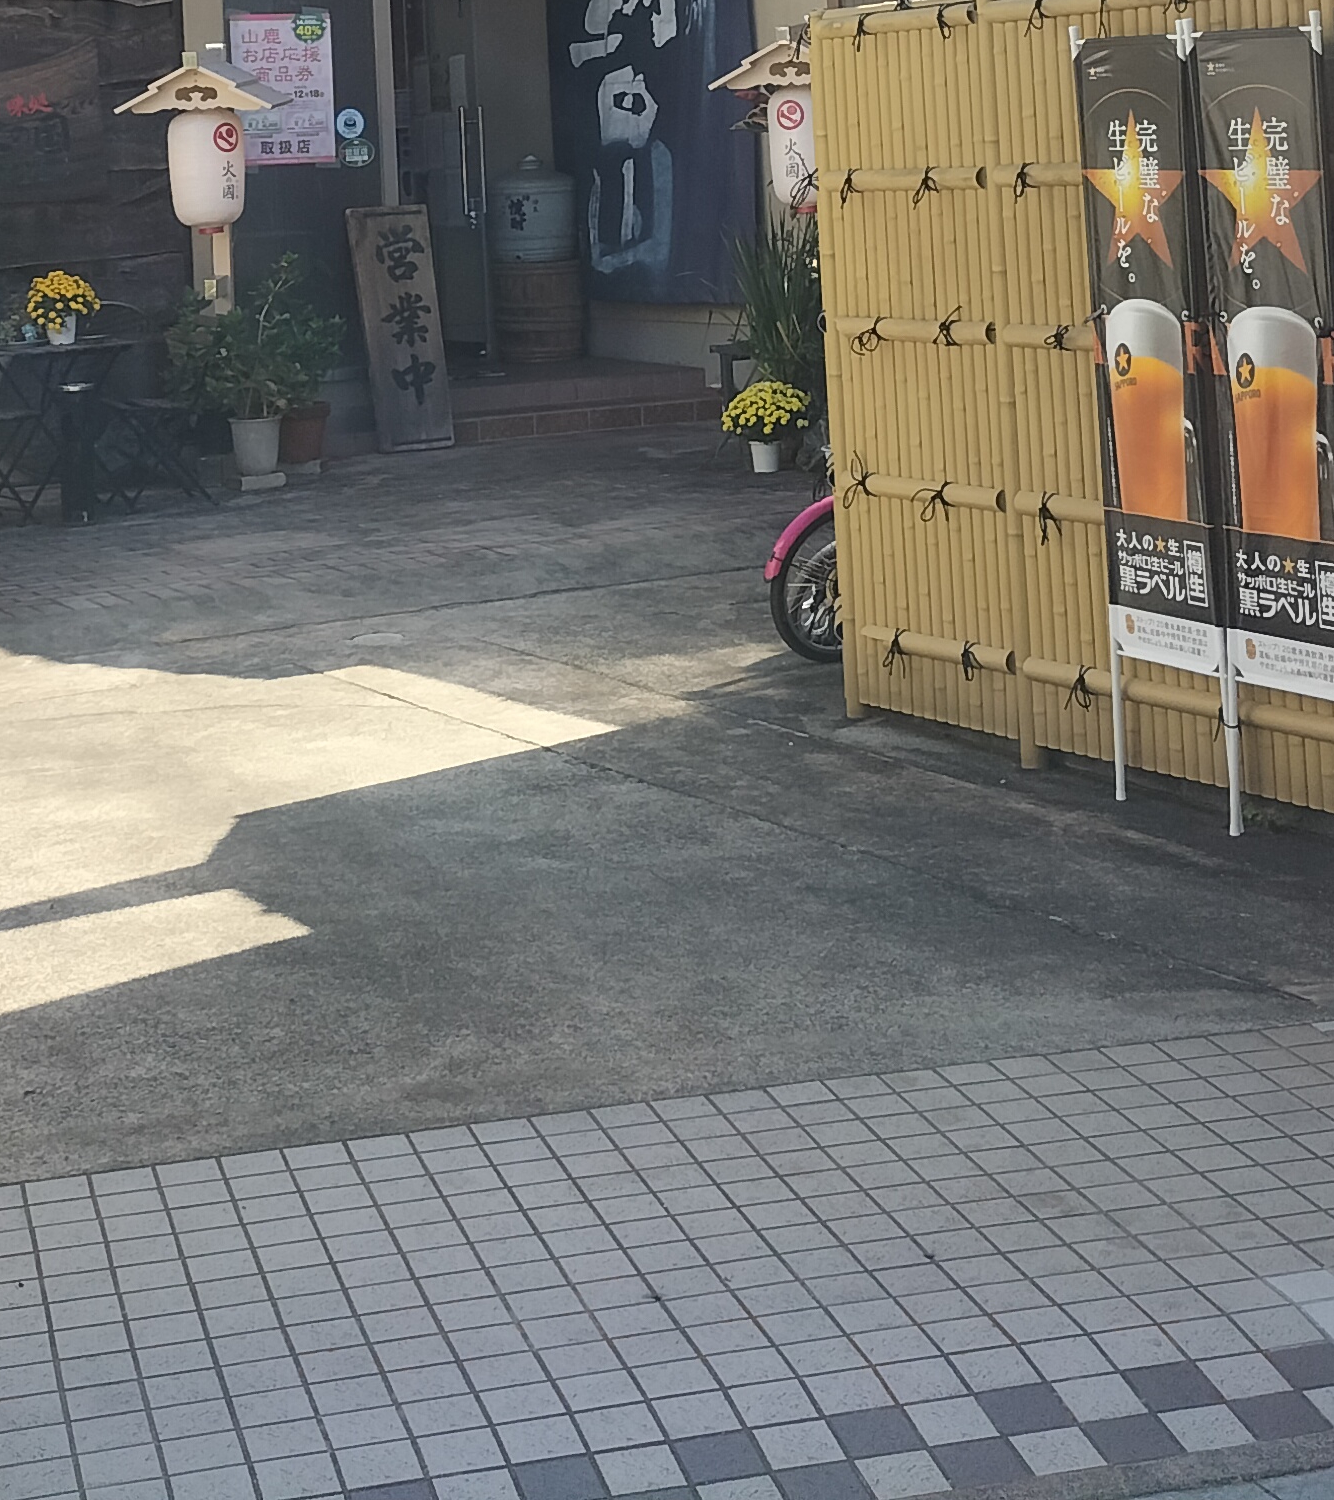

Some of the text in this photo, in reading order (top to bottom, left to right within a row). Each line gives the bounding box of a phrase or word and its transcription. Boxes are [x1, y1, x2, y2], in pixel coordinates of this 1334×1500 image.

[241, 28, 282, 45] 山鹿
[242, 46, 322, 64] お店応援
[252, 66, 315, 83] 商品券
[260, 139, 311, 155] 取扱店
[1135, 119, 1161, 223] 完璧な
[1262, 116, 1291, 226] 完璧な
[1108, 119, 1137, 283] 生ビールを。
[1228, 117, 1261, 290] 生ビールを。
[375, 223, 437, 405] 営業中
[1116, 529, 1154, 551] 大人の
[1118, 551, 1184, 575] サッポロ生ビール
[1187, 549, 1205, 598] 樽生
[1236, 549, 1280, 573] 大人の
[1120, 565, 1185, 601] 黒ラベル
[1237, 571, 1315, 598] サッポロ生ビール
[1239, 587, 1317, 626] 黒ラベル
